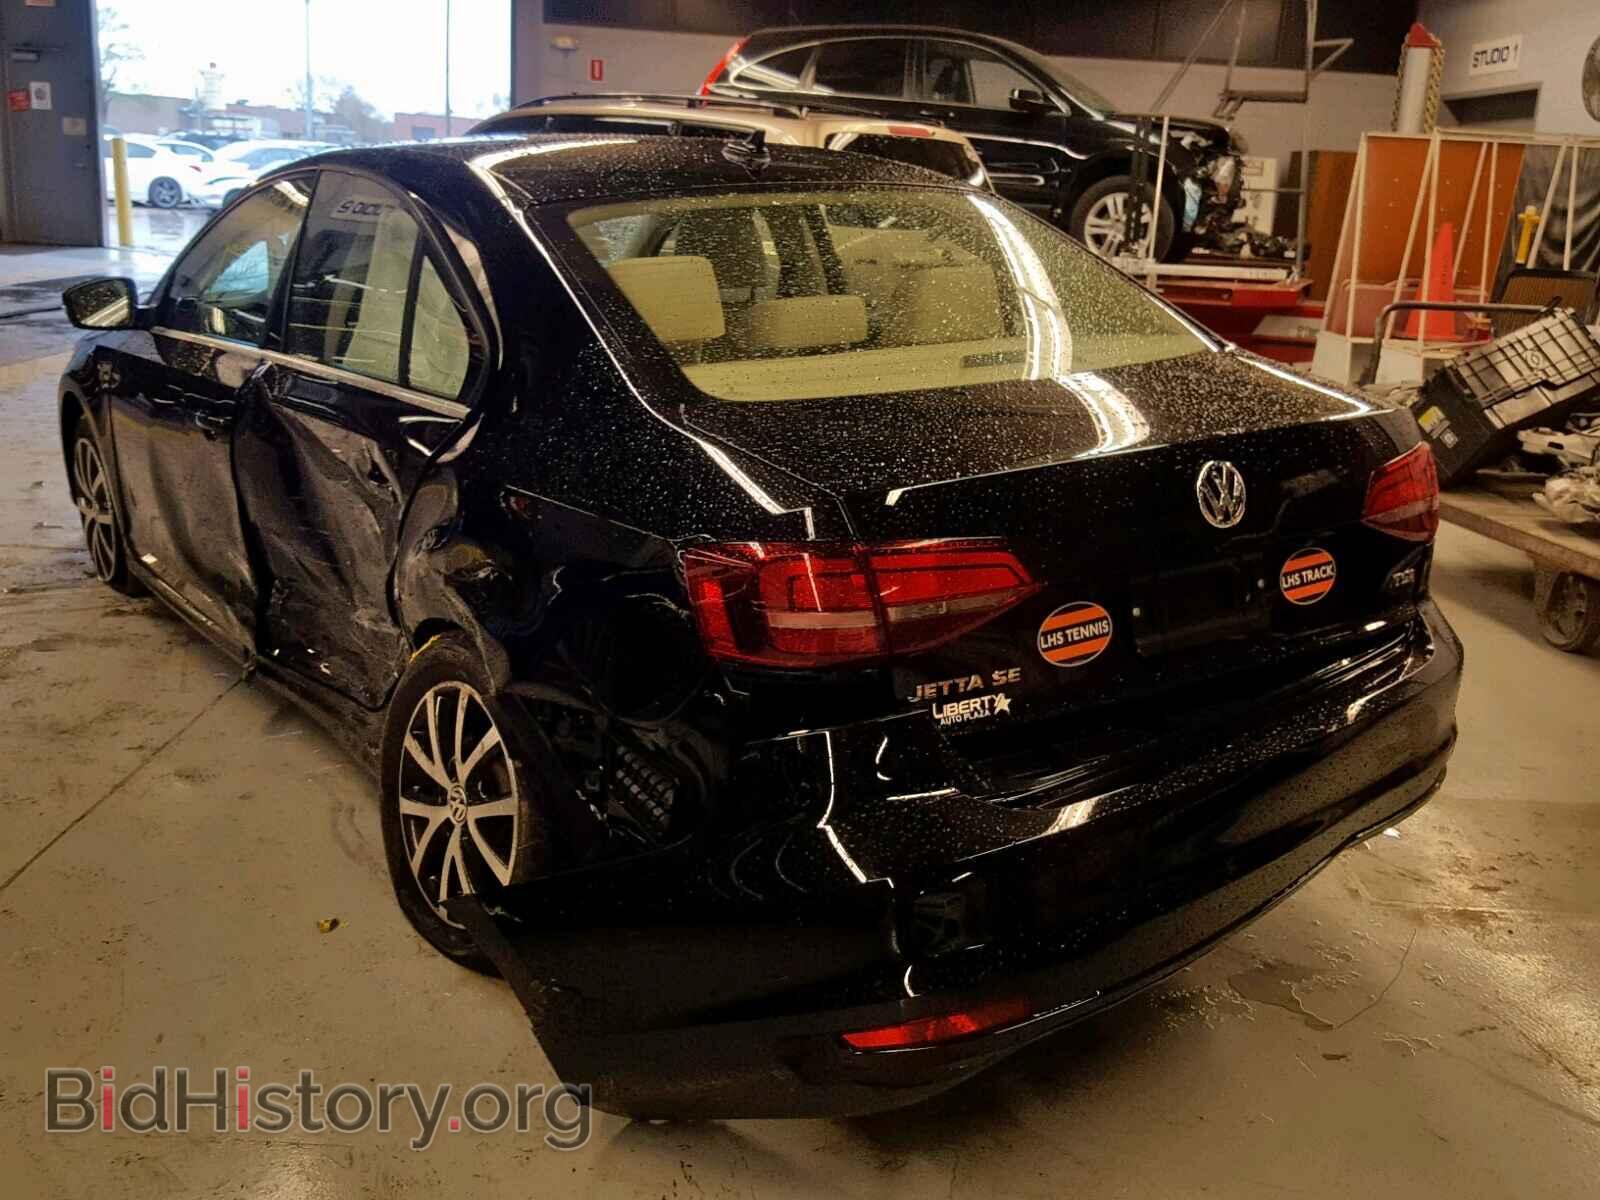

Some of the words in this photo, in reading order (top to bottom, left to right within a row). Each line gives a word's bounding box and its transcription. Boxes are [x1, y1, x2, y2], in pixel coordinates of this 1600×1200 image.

[1471, 45, 1510, 68] STUDIO
[1281, 573, 1301, 588] LHS
[1301, 564, 1335, 583] TRACK
[1040, 631, 1064, 649] LHS
[1065, 619, 1109, 642] TENNIS
[907, 674, 984, 702] JETTA
[991, 667, 1021, 686] SE
[932, 693, 1004, 720] LIBERTY
[940, 714, 963, 726] AUTO
[964, 709, 991, 721] PLAZA
